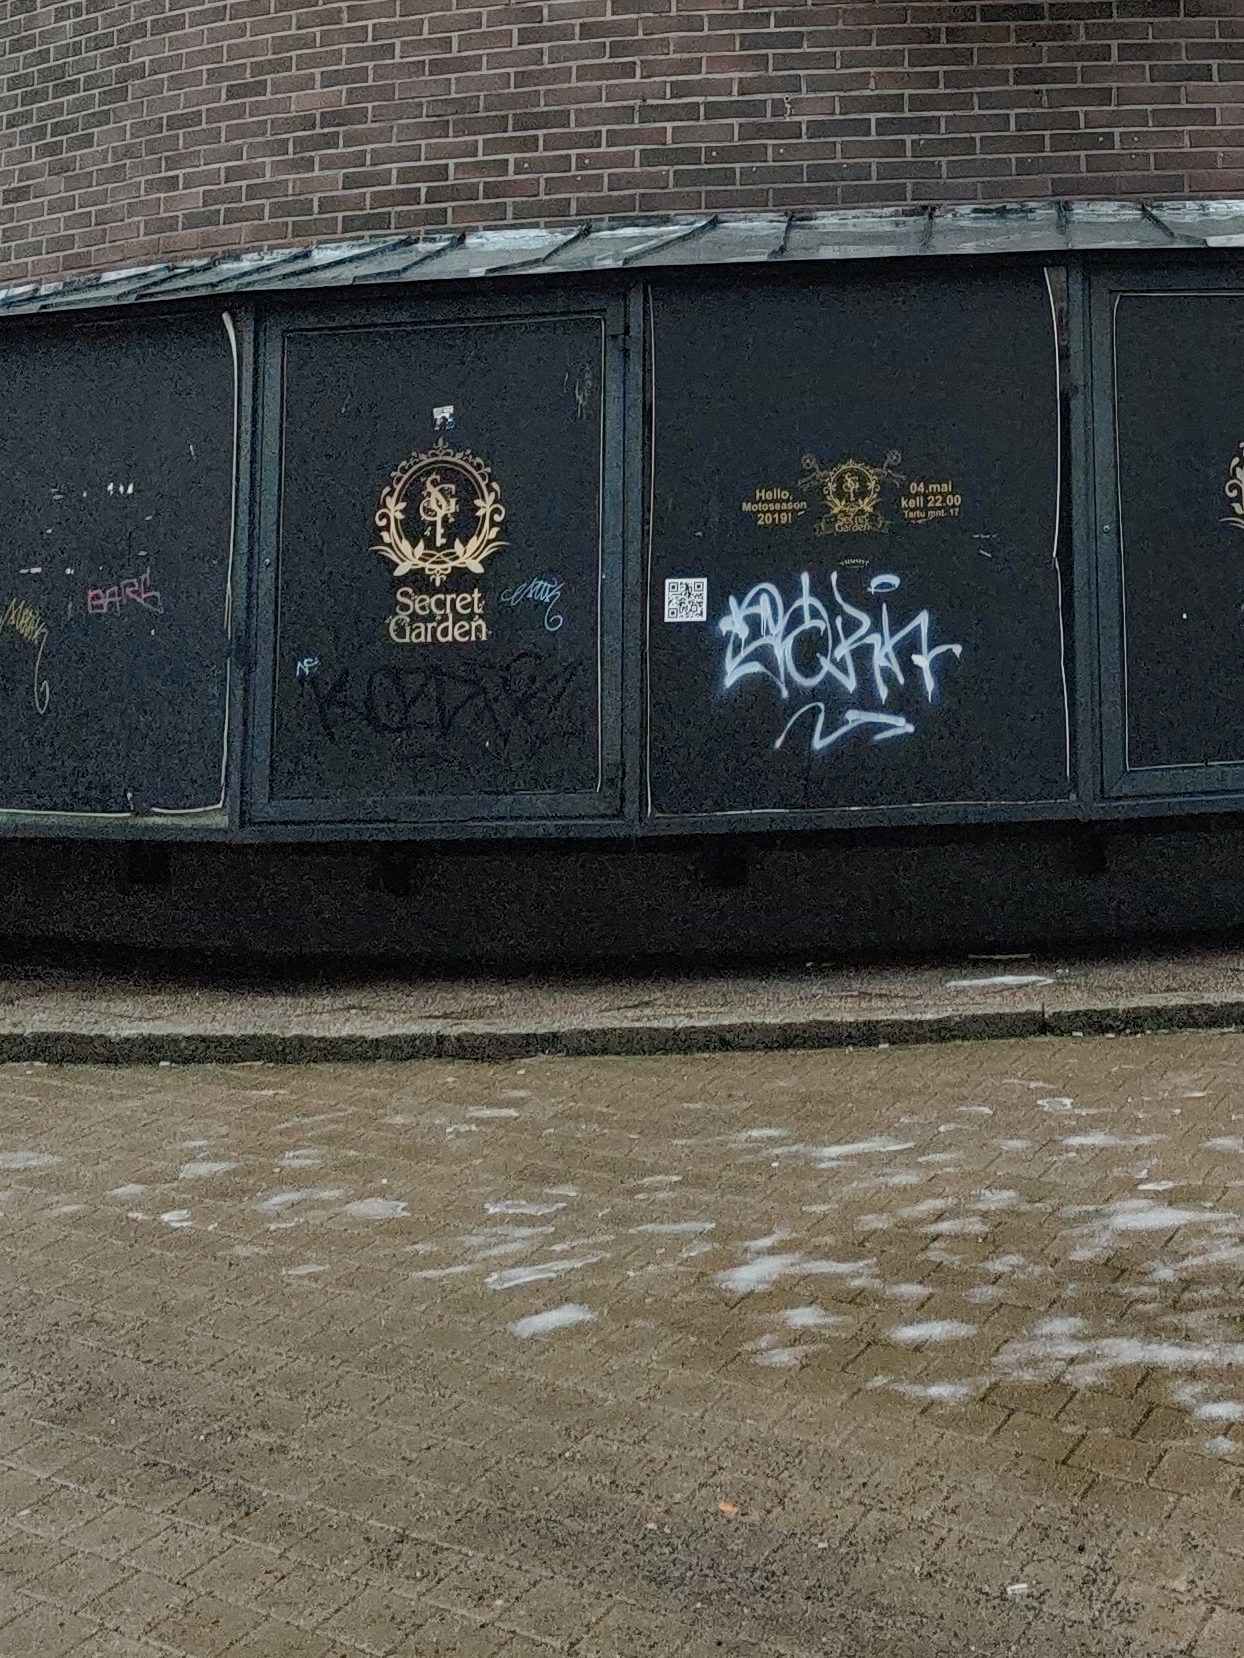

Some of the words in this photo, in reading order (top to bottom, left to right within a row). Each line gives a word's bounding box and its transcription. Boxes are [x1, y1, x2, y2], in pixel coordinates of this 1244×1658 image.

[910, 480, 952, 494] 04.mai
[755, 488, 793, 501] Hello,
[742, 502, 807, 511] Motoseason
[902, 495, 924, 509] kell
[927, 495, 962, 507] 22.00
[757, 512, 792, 525] 2019!
[903, 509, 926, 519] Tartu
[395, 587, 485, 616] Secret
[388, 613, 489, 643] Garden
